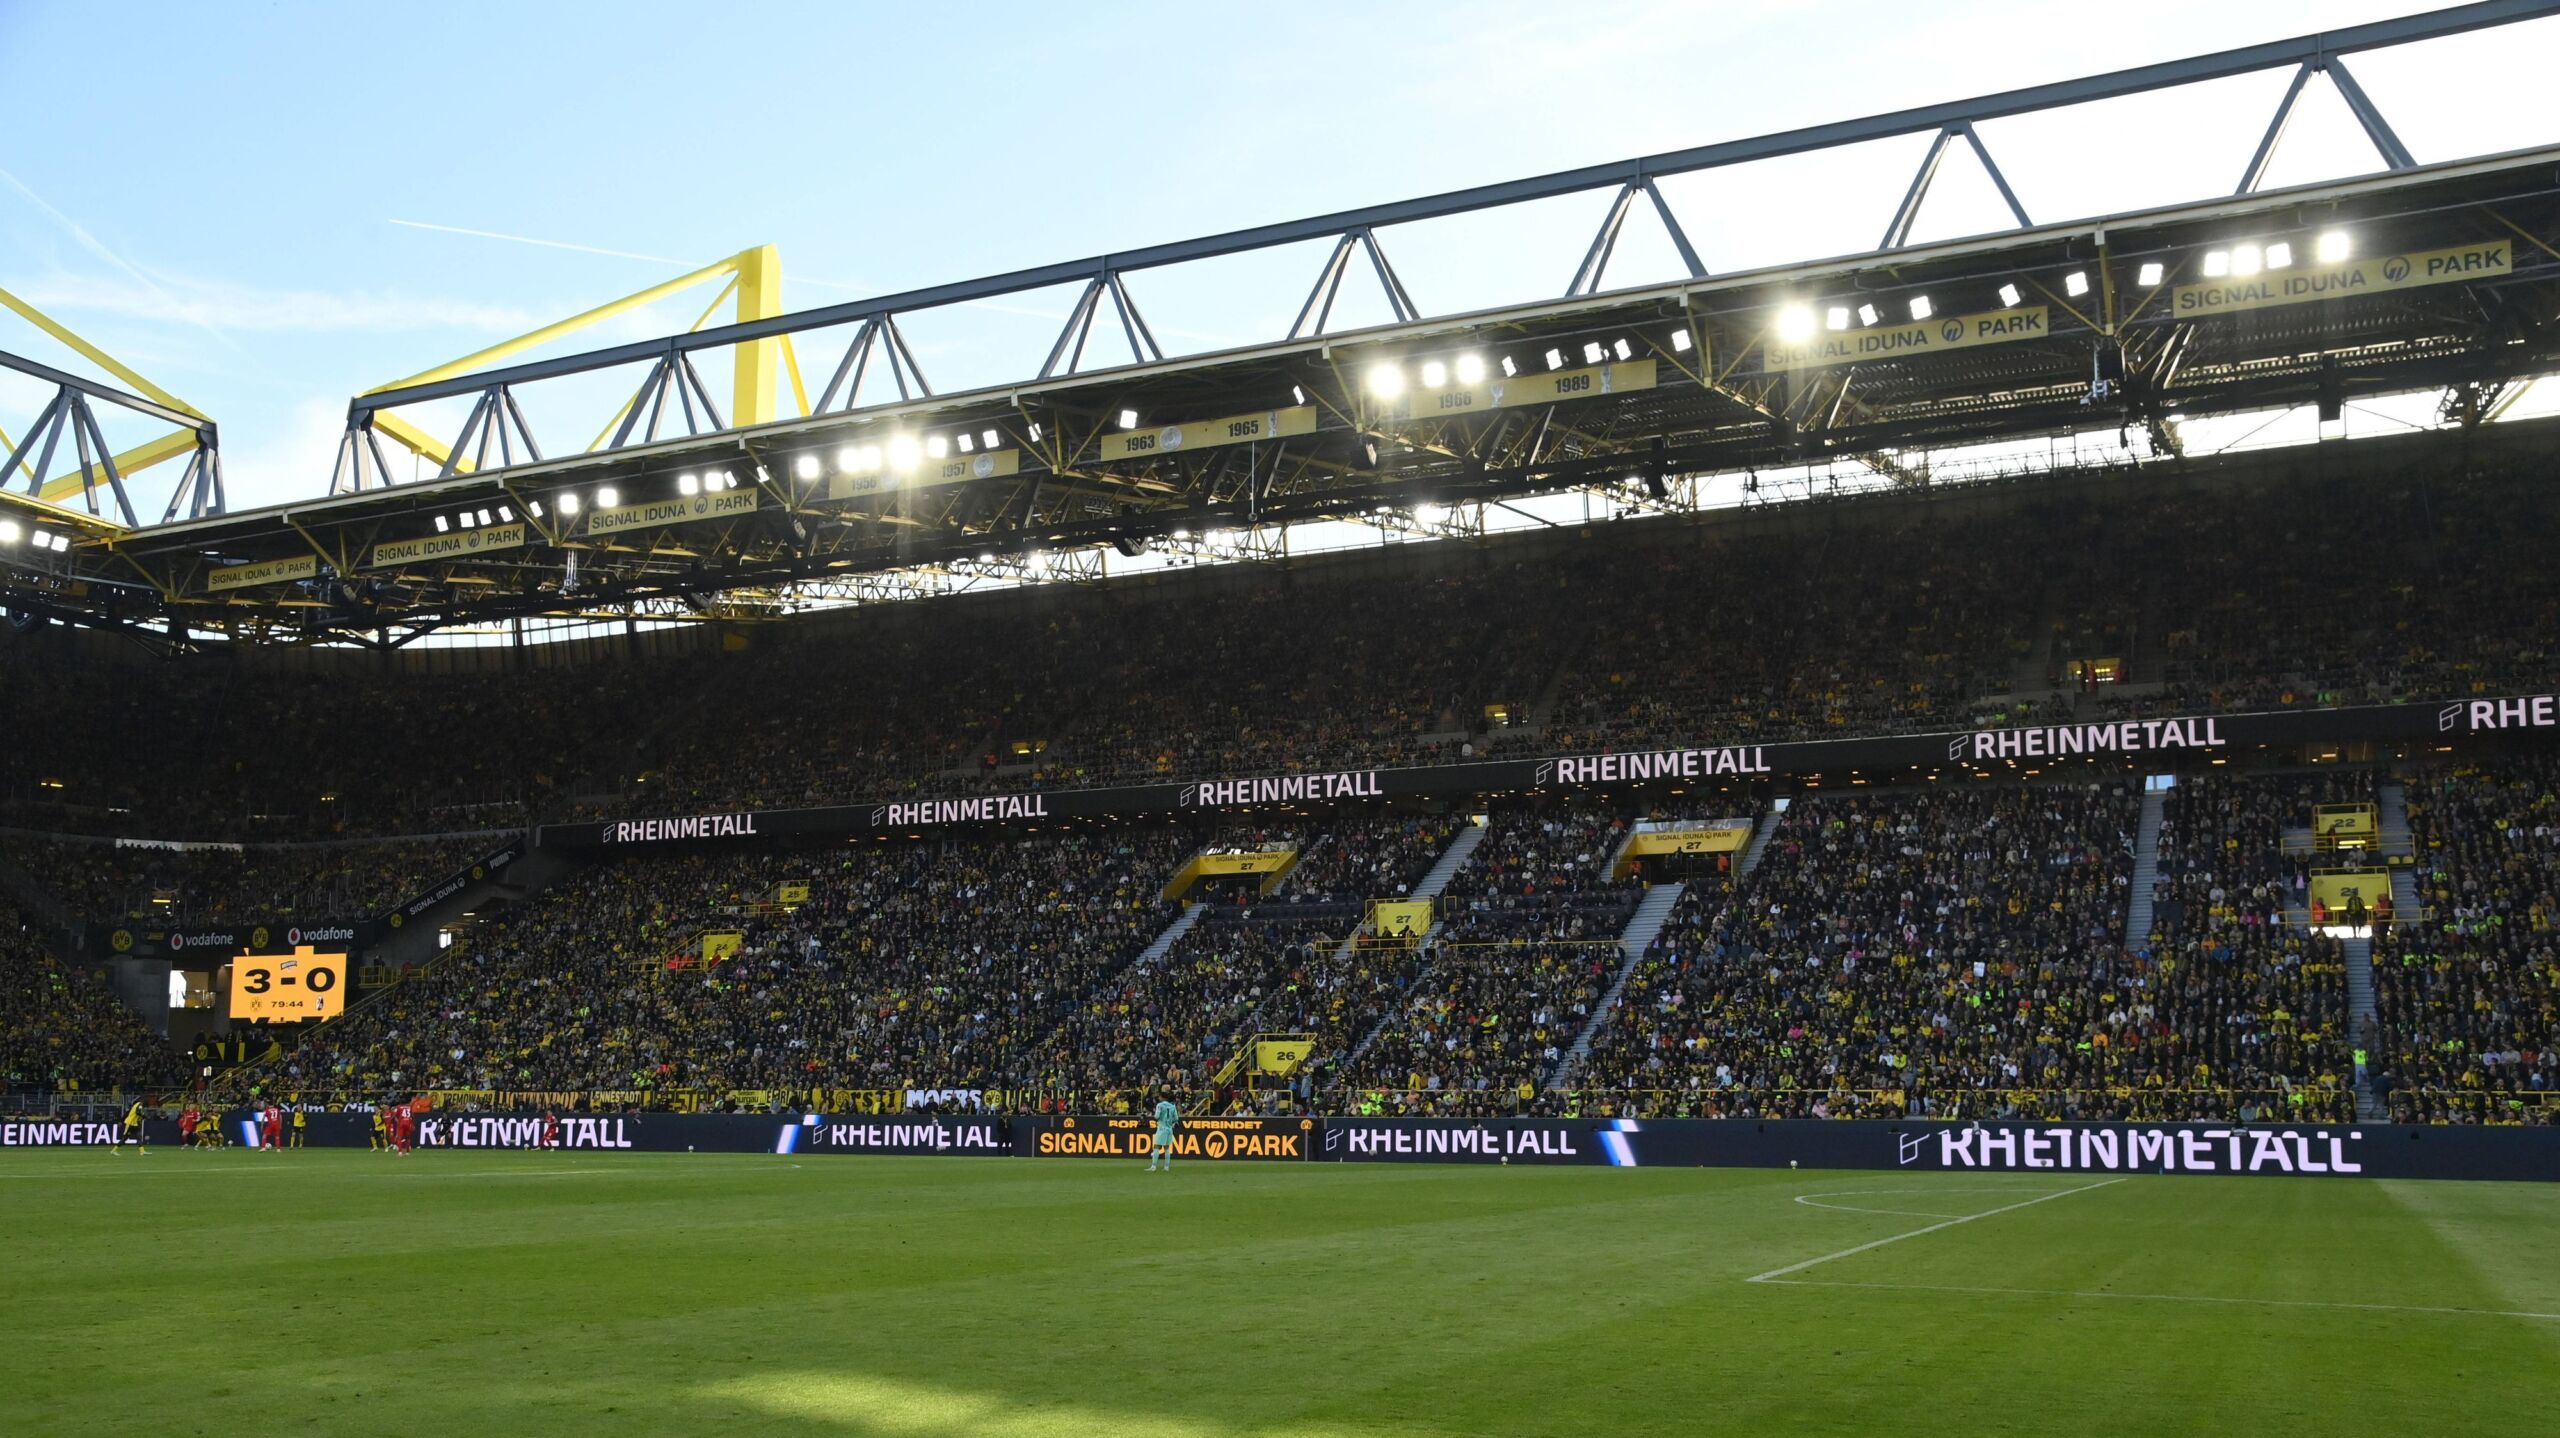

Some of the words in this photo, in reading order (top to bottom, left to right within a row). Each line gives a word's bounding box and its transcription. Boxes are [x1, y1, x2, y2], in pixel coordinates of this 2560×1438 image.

[2180, 282, 2276, 311] SIGNAL
[2283, 269, 2367, 296] IDUNA
[2426, 249, 2505, 276] PARK
[1771, 340, 1851, 365] SIGNAL
[1858, 330, 1928, 353] IDUNA
[1978, 313, 2041, 337] PARK
[1555, 374, 1590, 394] 1989
[1438, 392, 1472, 409] 1966
[1228, 420, 1259, 438] 1965
[1125, 434, 1155, 452] 1963
[942, 462, 966, 478] 1957
[852, 477, 877, 491] 1956
[592, 511, 640, 530] SIGNAL
[644, 504, 686, 521] IDUNA
[715, 494, 753, 512] PARK
[376, 545, 420, 562] SIGNAL
[424, 538, 461, 555] IDUNA
[487, 529, 520, 545] PARK
[211, 573, 242, 585] SIGNAL
[245, 568, 271, 579] IDUNA
[288, 561, 312, 574] PARK
[2470, 696, 2560, 730] RHE
[1974, 718, 2226, 759] RHEINMETALL
[1557, 747, 1771, 784] RHEINMETALL
[1199, 772, 1383, 807] RHEINMETALL
[887, 794, 1048, 826] RHEINMETALL
[617, 814, 757, 843] RHEINMETALL
[2335, 818, 2356, 828] 22
[1686, 841, 1702, 850] 27
[1713, 831, 1732, 839] PARK
[1241, 862, 1254, 871] 27
[409, 896, 436, 916] SIGNAL
[436, 883, 458, 901] IDUNA
[1396, 915, 1411, 924] 27
[185, 932, 234, 947] vodafone
[303, 927, 354, 942] vodafone
[1276, 1051, 1296, 1061] 26
[0, 1123, 138, 1145] EINMETAL
[831, 1124, 1012, 1148] RHEINMETAL
[1183, 1120, 1263, 1130] VERBINDET
[1040, 1132, 1122, 1154] SIGNAL
[1233, 1134, 1299, 1156] PARK
[1350, 1128, 1577, 1155] RHEINMETALL
[1939, 1129, 2362, 1173] RHEINMETALL
